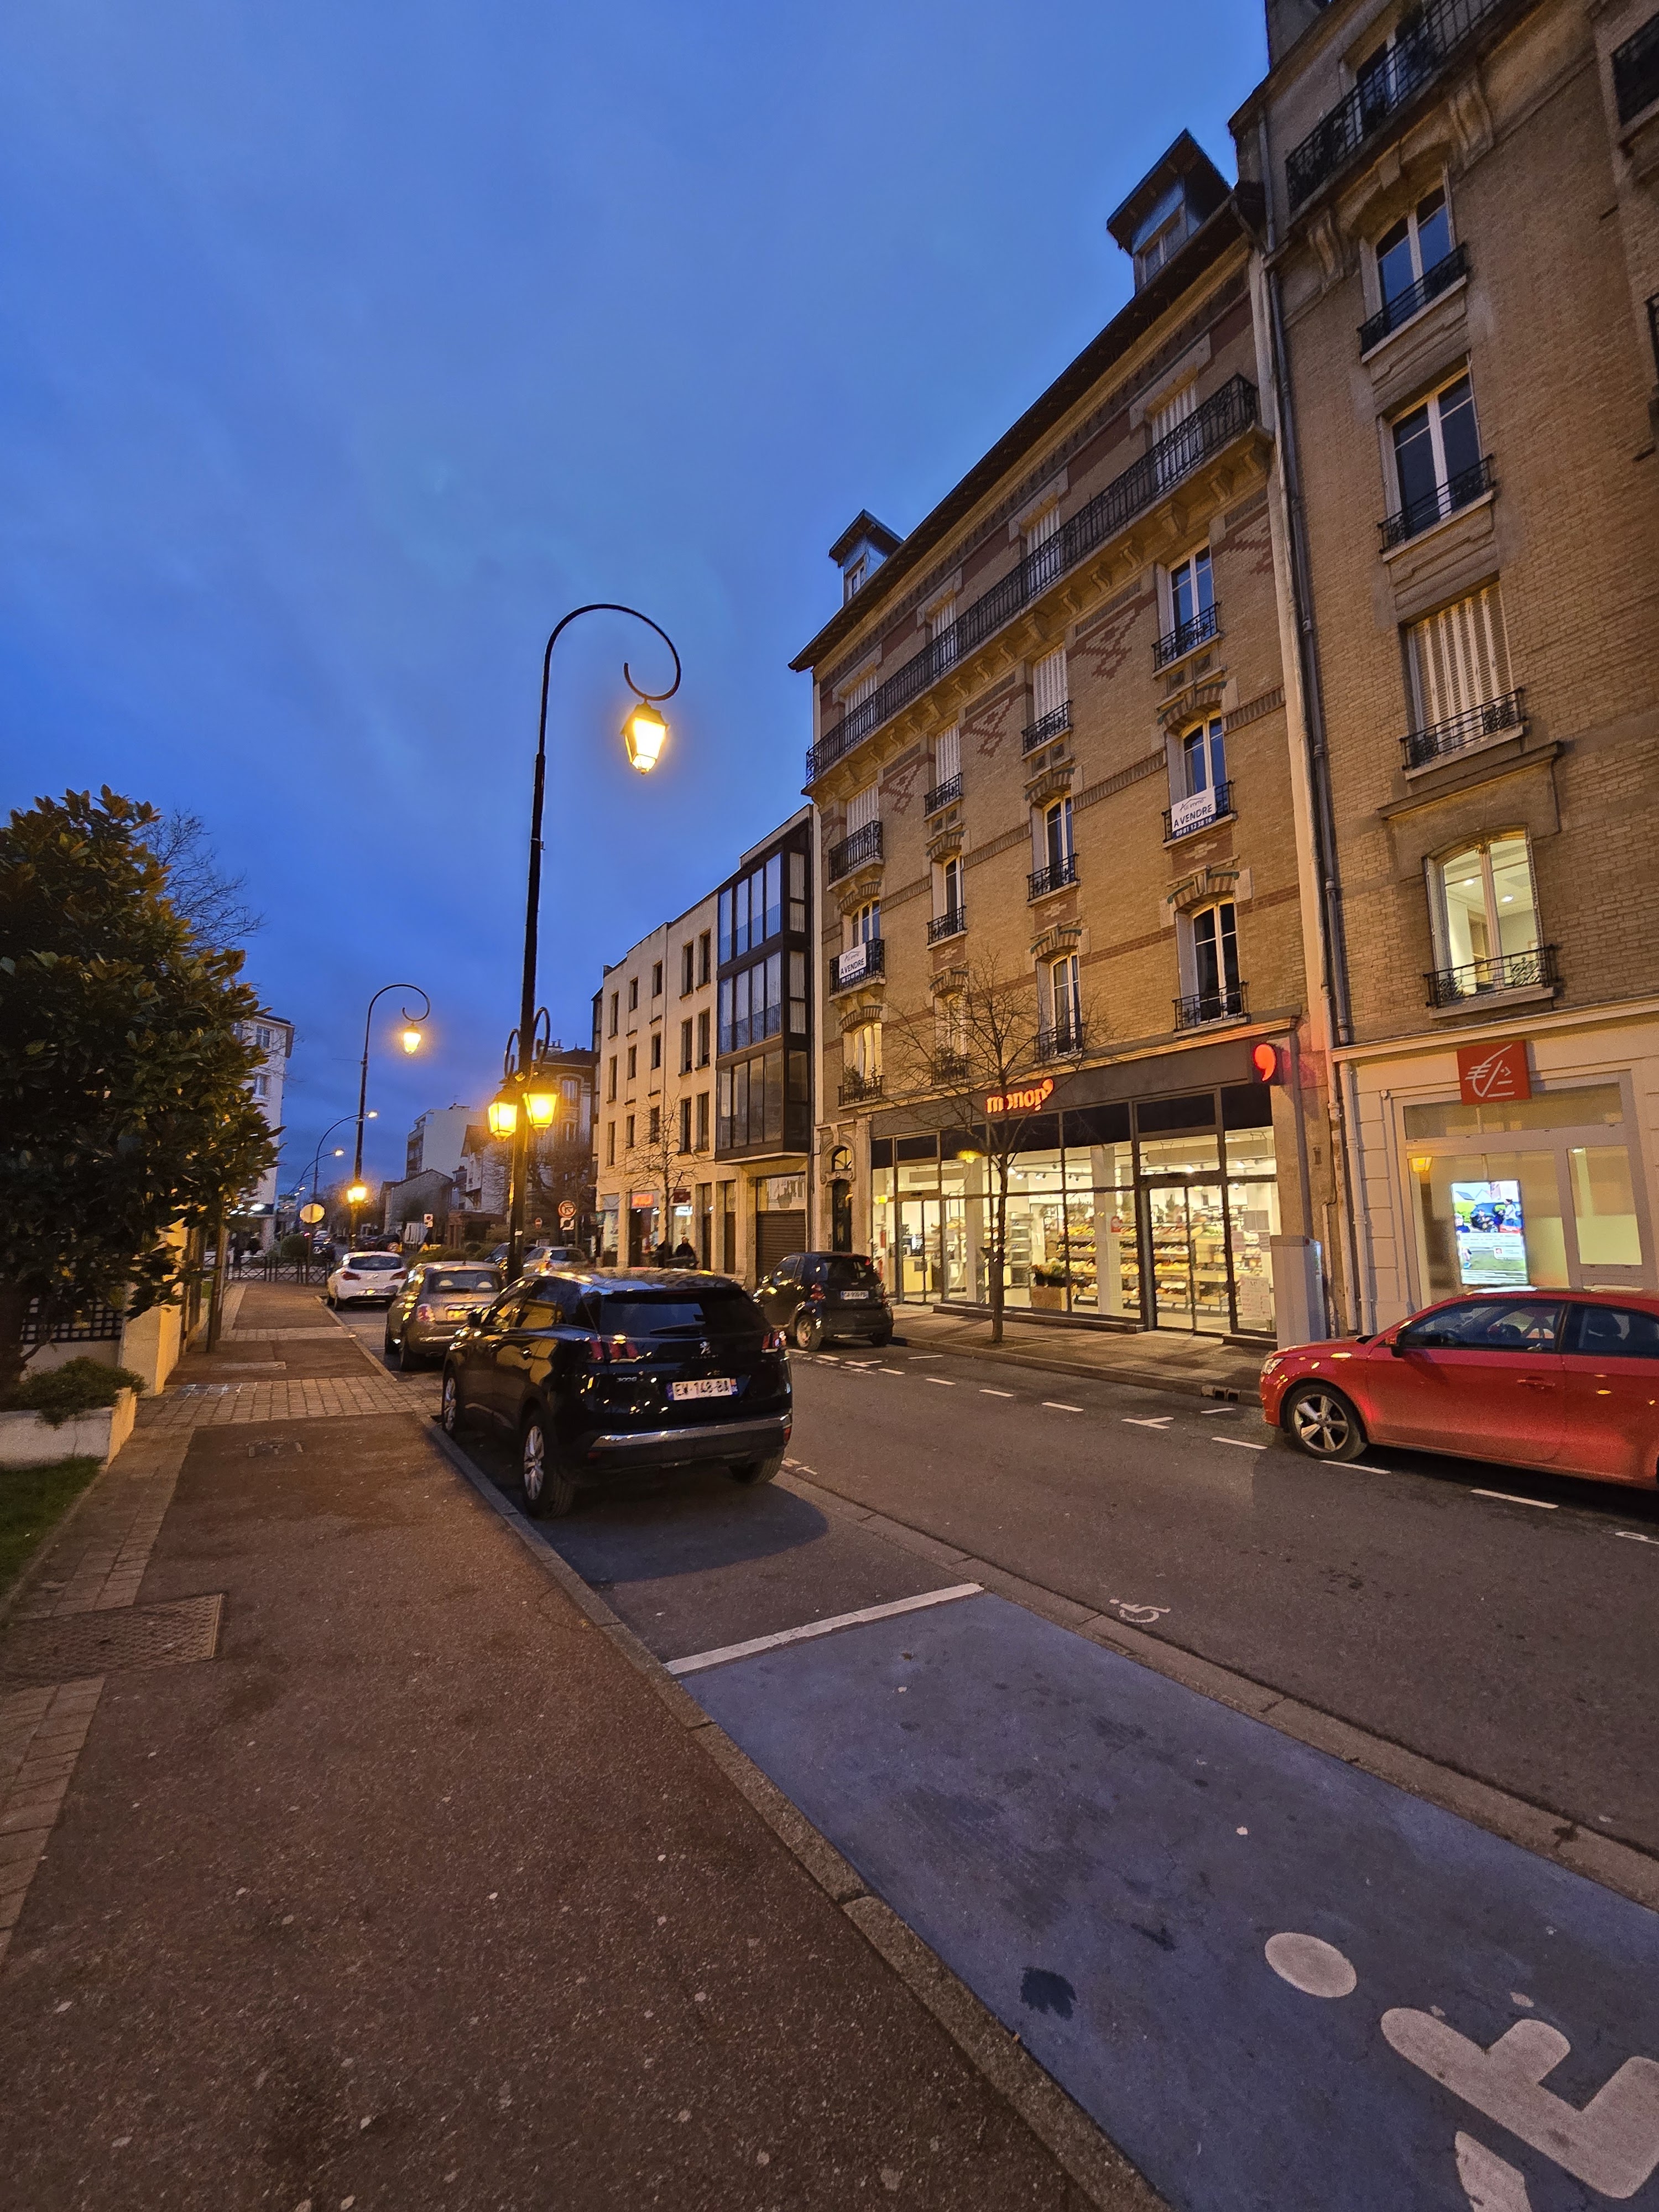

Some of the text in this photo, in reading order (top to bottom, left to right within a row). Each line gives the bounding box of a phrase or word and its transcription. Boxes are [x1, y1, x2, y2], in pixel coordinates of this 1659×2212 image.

[1174, 804, 1212, 828] A VENDRE
[844, 958, 864, 973] VENDRE
